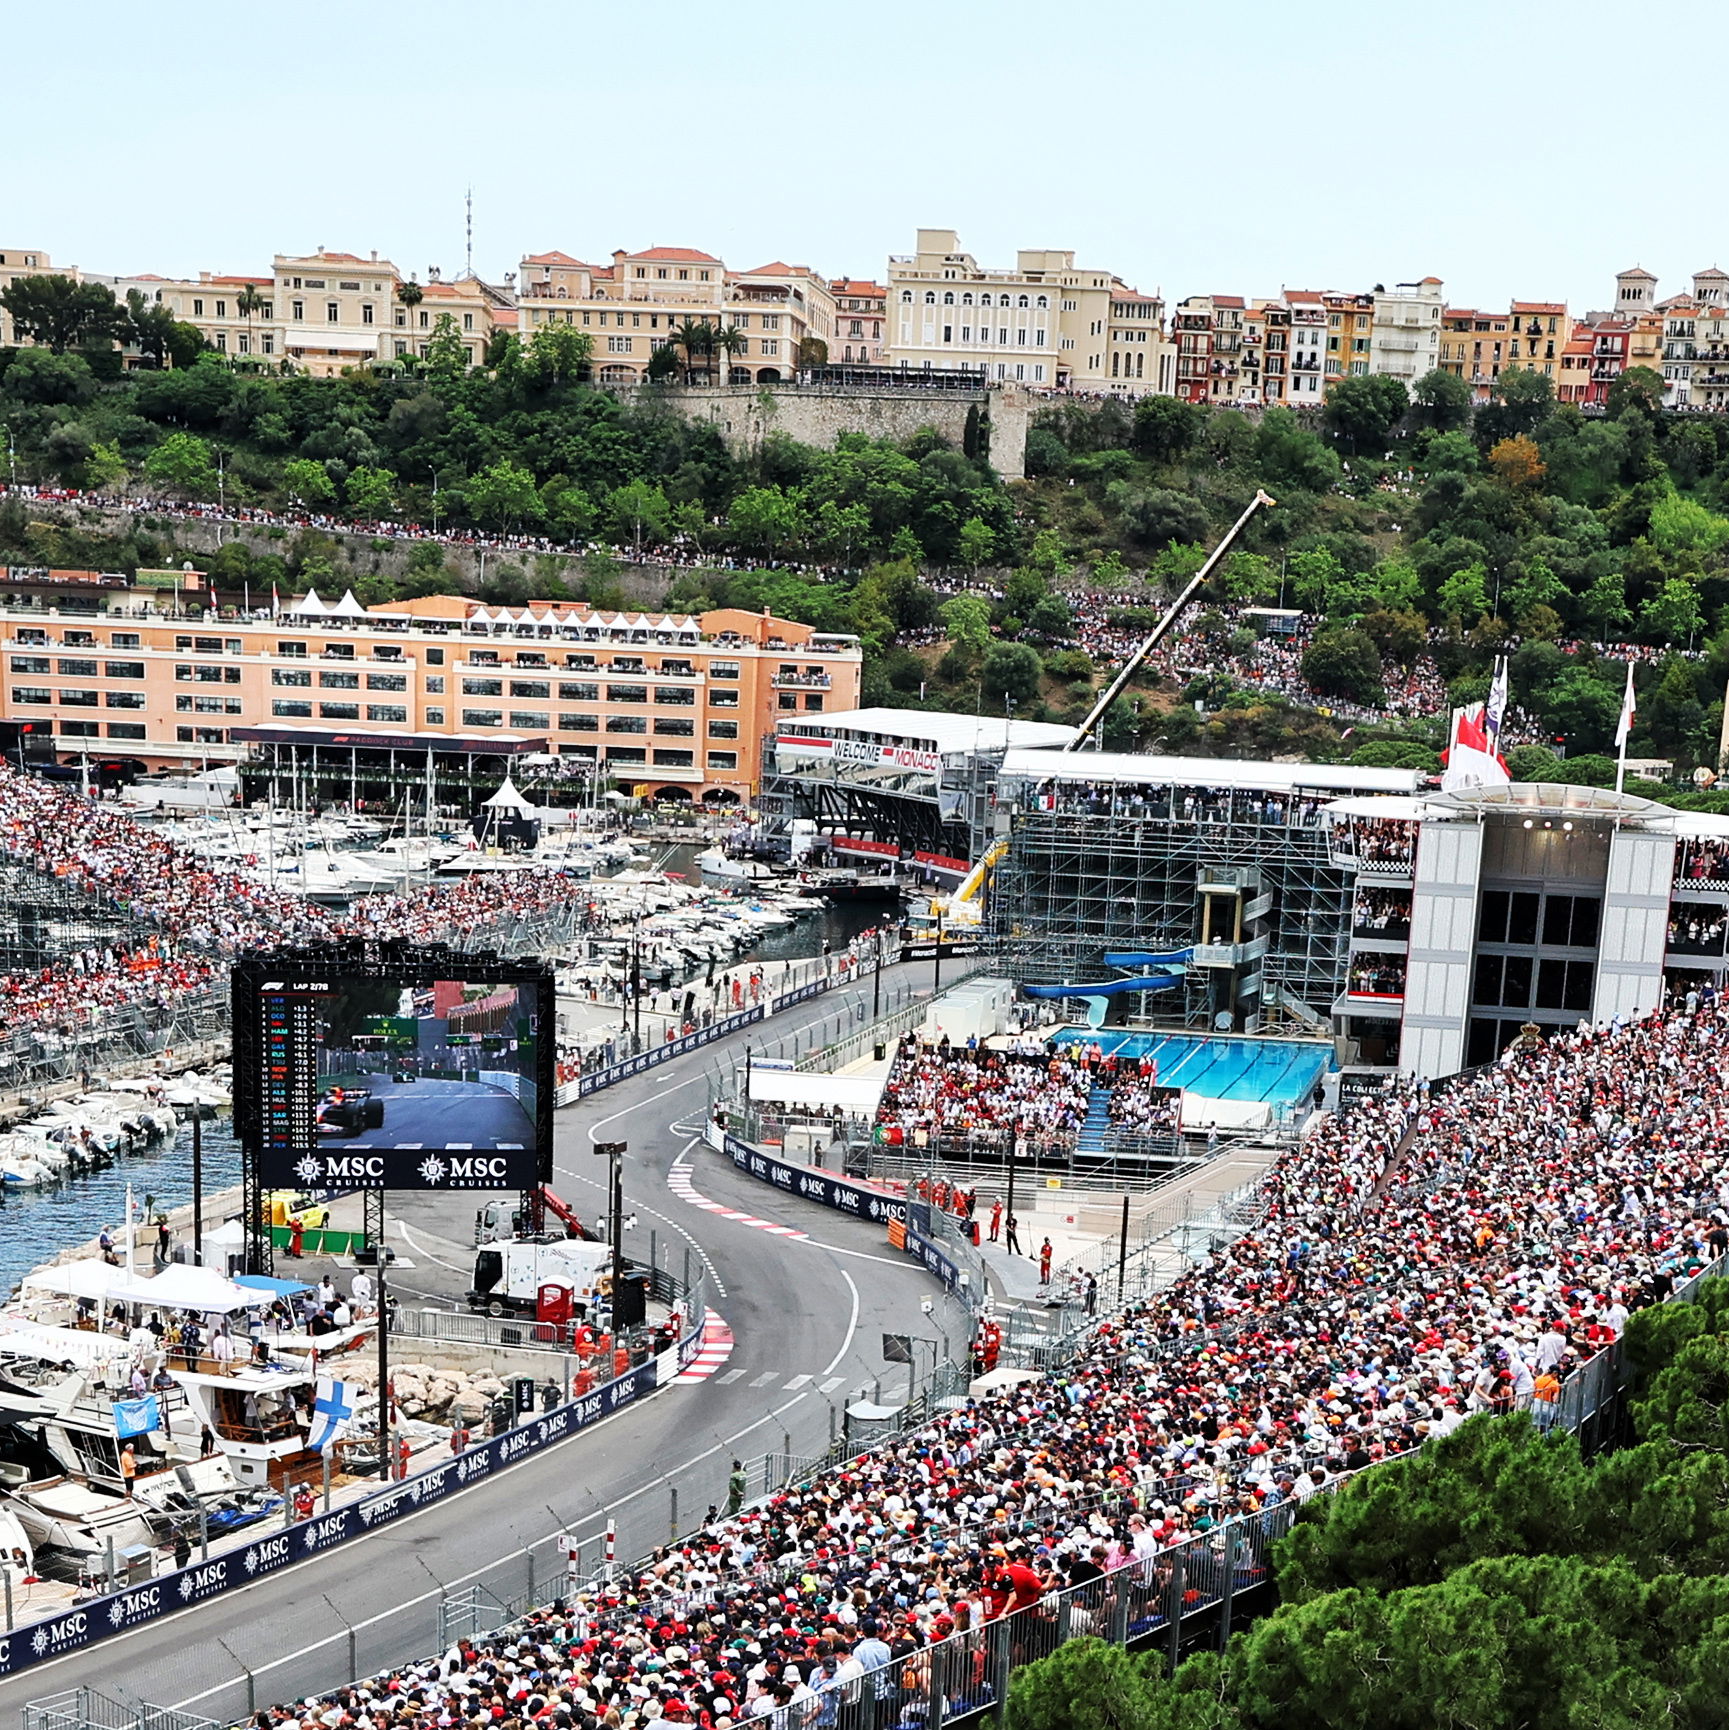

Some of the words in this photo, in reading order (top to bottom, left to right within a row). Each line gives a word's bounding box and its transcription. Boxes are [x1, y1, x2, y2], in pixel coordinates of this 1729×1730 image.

[834, 741, 881, 763] WELCOME
[1342, 1083, 1350, 1092] LA
[326, 1157, 384, 1177] MSC
[450, 1158, 507, 1178] MSC
[777, 1167, 792, 1185] MSC
[808, 1178, 825, 1196] MSC
[841, 1189, 859, 1208] MSC
[880, 1202, 906, 1219] MSC
[618, 1377, 635, 1398] MSC
[584, 1394, 602, 1417] MSC
[548, 1412, 568, 1435] MSC
[509, 1430, 530, 1454] MSC
[467, 1450, 489, 1473] MSC
[421, 1470, 446, 1494] MSC
[318, 1514, 346, 1540] MSC
[259, 1536, 289, 1564] MSC
[195, 1562, 226, 1590] MSC
[125, 1587, 160, 1616] MSC
[50, 1614, 88, 1644] MSC
